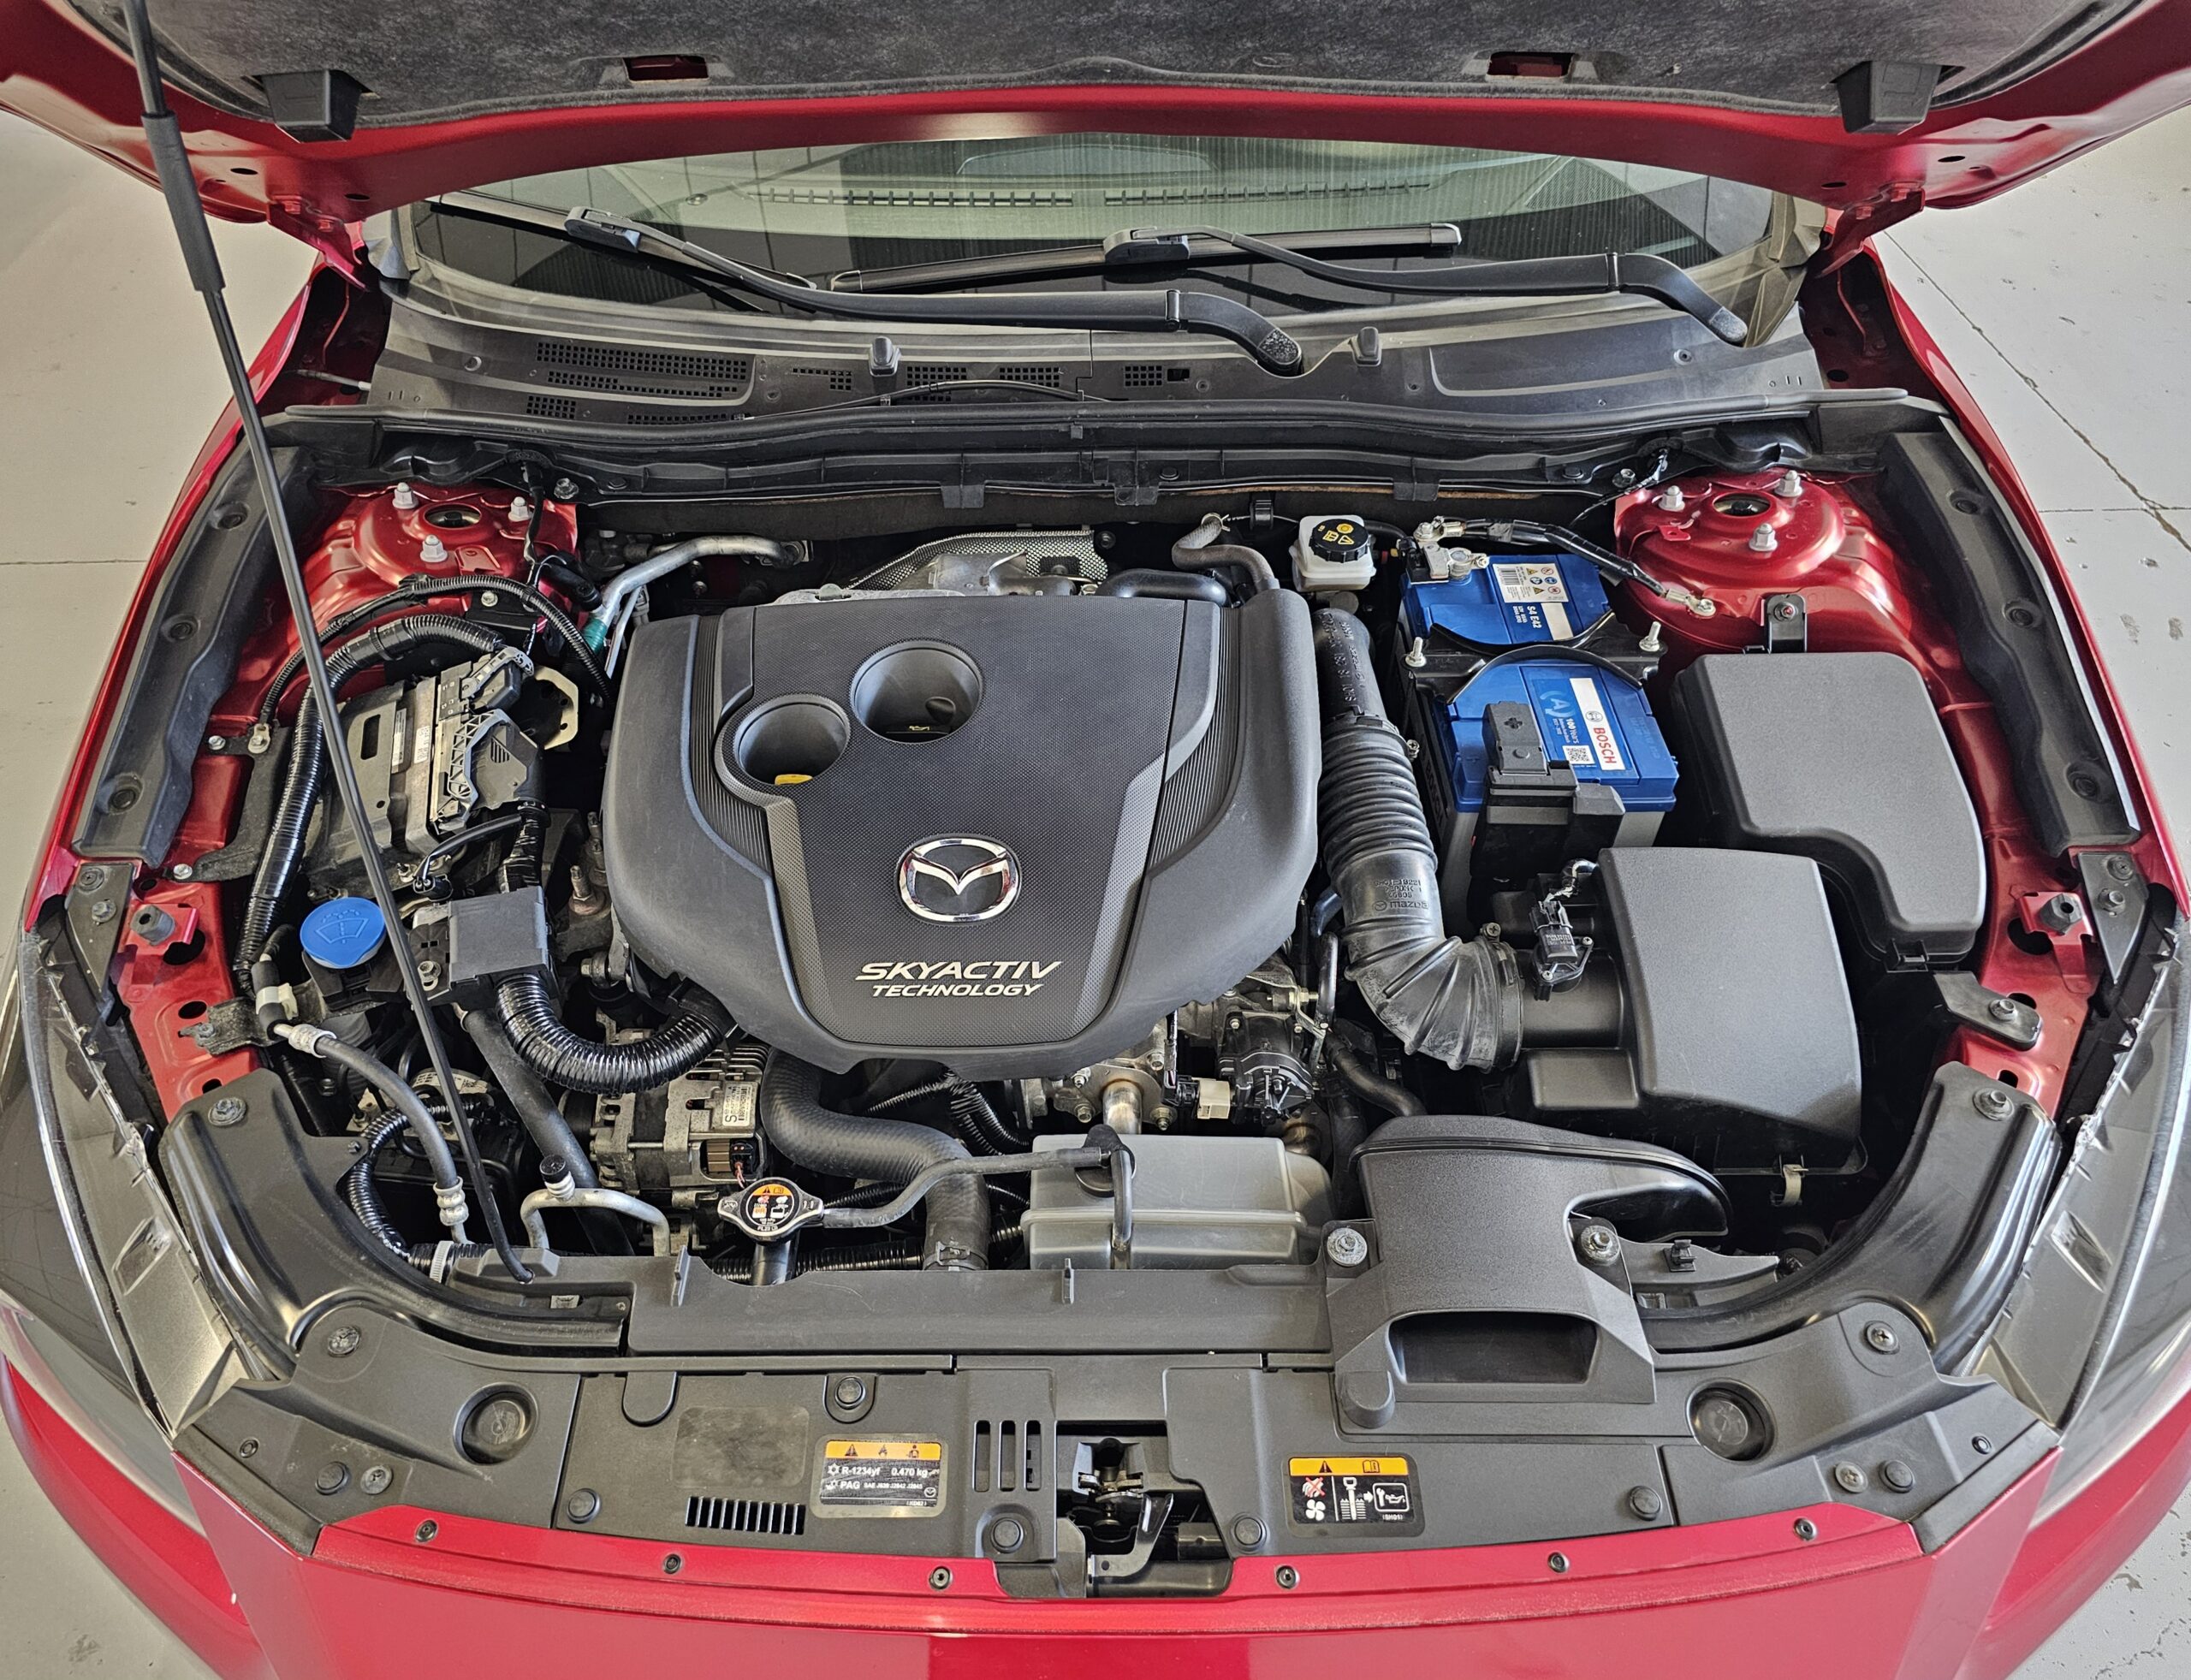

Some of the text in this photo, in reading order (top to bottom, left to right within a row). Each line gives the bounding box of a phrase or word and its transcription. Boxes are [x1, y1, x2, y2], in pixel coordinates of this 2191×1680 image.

[1565, 718, 1576, 731] 100
[1593, 727, 1617, 763] BOSCH
[1390, 900, 1428, 909] mazda
[855, 961, 1062, 980] SKYACTIV
[872, 984, 1044, 997] TECHNOLOGY
[841, 1466, 928, 1478] R-1234yf 0.470 kg
[840, 1481, 861, 1489] PAG
